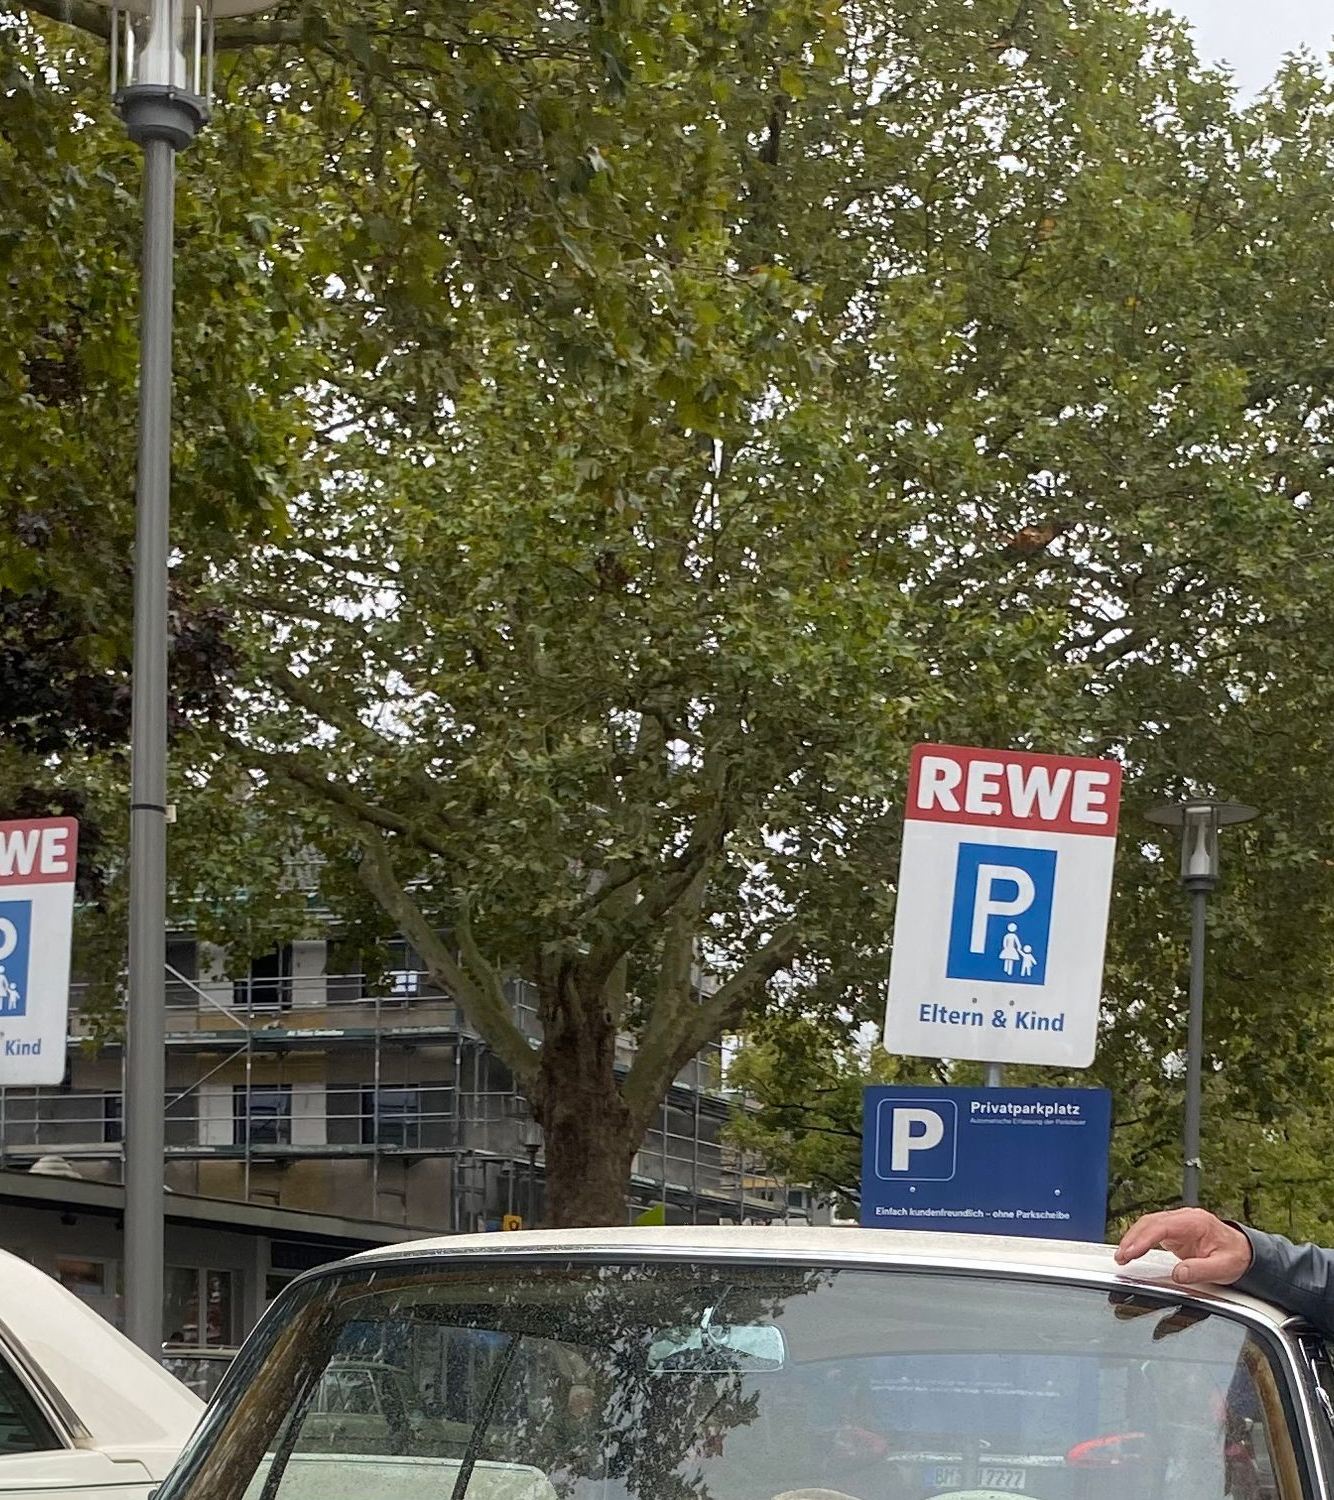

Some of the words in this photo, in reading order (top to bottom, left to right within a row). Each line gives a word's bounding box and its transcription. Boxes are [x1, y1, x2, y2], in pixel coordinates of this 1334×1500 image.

[917, 756, 1110, 824] REWE
[970, 864, 1035, 954] P
[919, 1004, 983, 1027] Eltern
[991, 1010, 1007, 1029] &
[1016, 1011, 1064, 1032] Kind
[5, 1039, 41, 1056] Kind
[971, 1101, 1080, 1118] Privatparkplatz
[891, 1108, 944, 1171] P
[875, 1206, 908, 1216] Einfach
[909, 1207, 984, 1218] kundenfreundlich
[993, 1209, 1014, 1219] ohne
[1017, 1210, 1070, 1220] Parkscheibe
